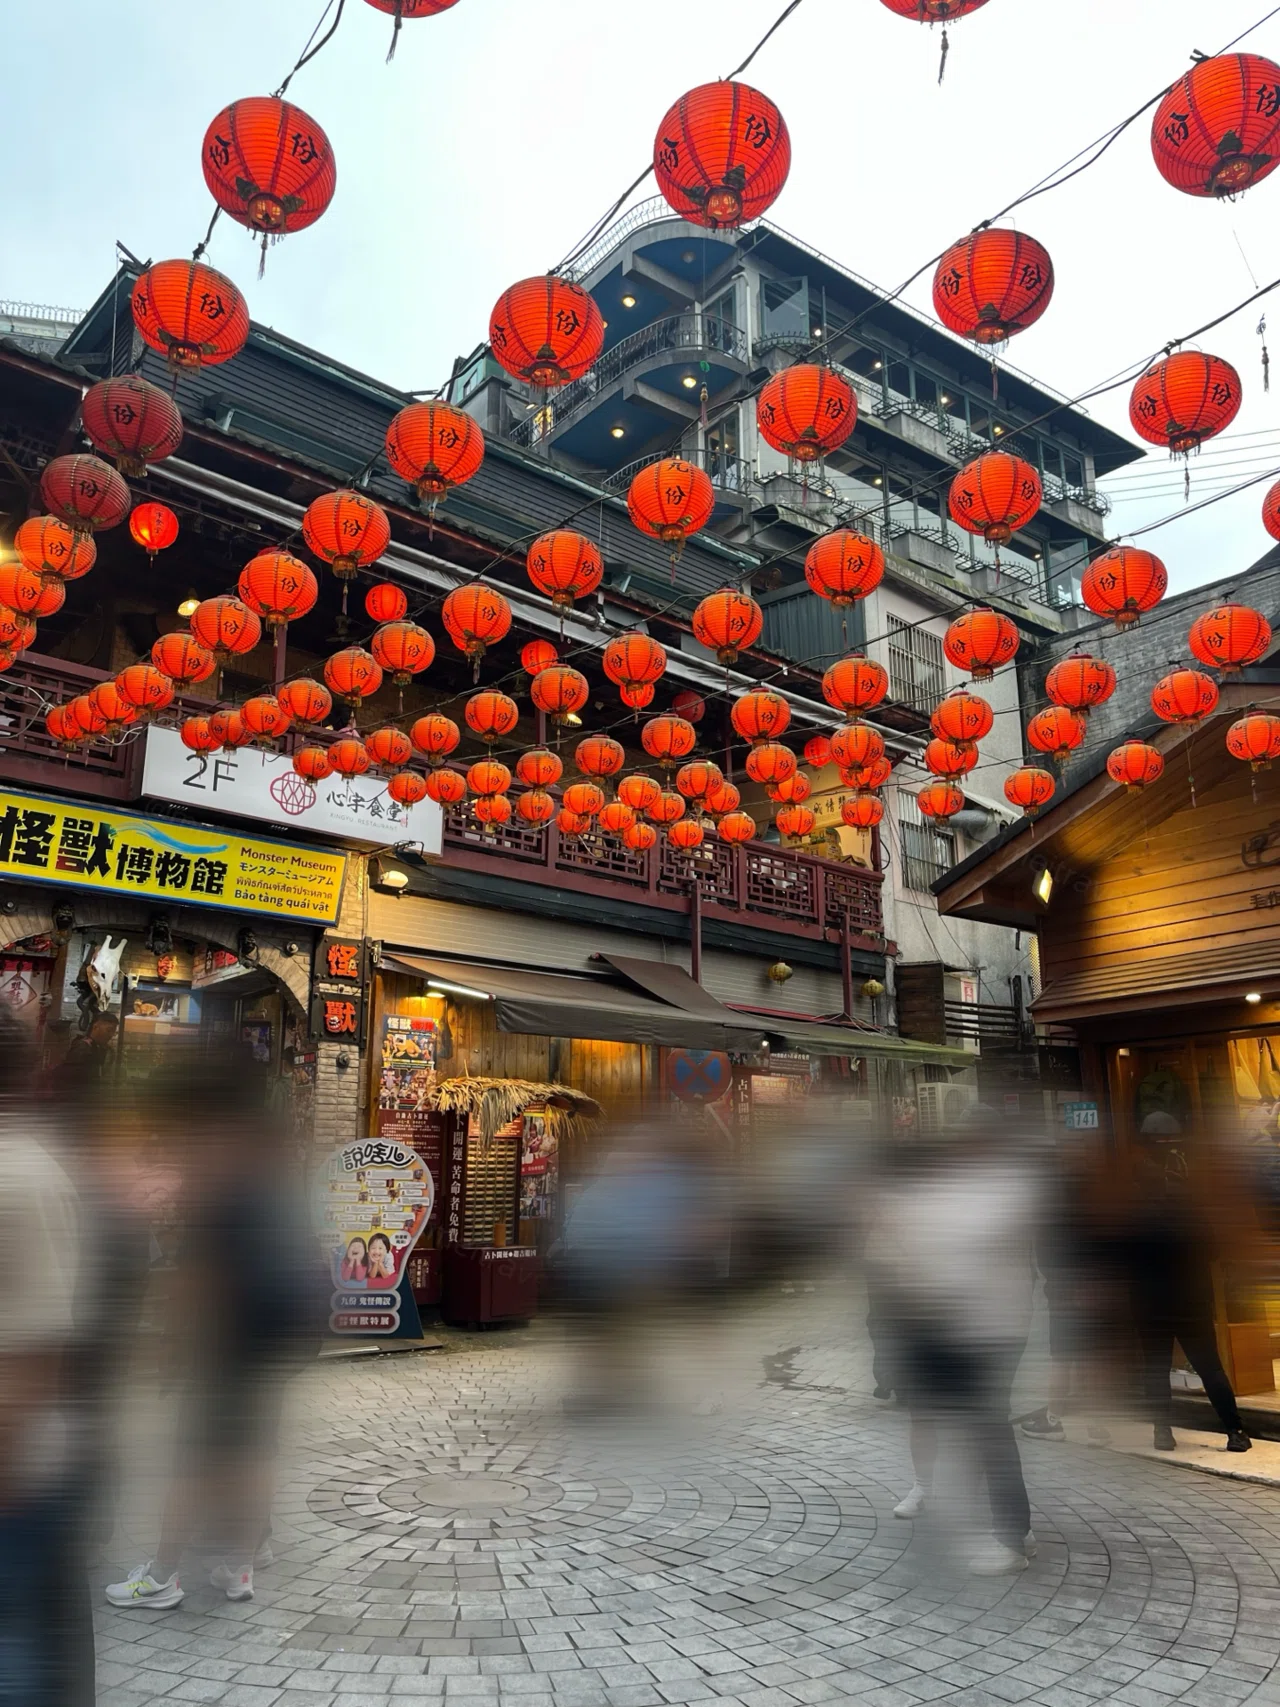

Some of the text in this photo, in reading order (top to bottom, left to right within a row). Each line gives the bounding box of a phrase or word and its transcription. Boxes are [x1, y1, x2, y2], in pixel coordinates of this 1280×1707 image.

[665, 461, 690, 506] 九份
[182, 754, 239, 792] 2F
[0, 805, 229, 896] 怪獸博物館
[240, 847, 337, 873] Monster Museum
[239, 862, 334, 886] モンスターミュージアム
[1075, 1111, 1095, 1126] 141
